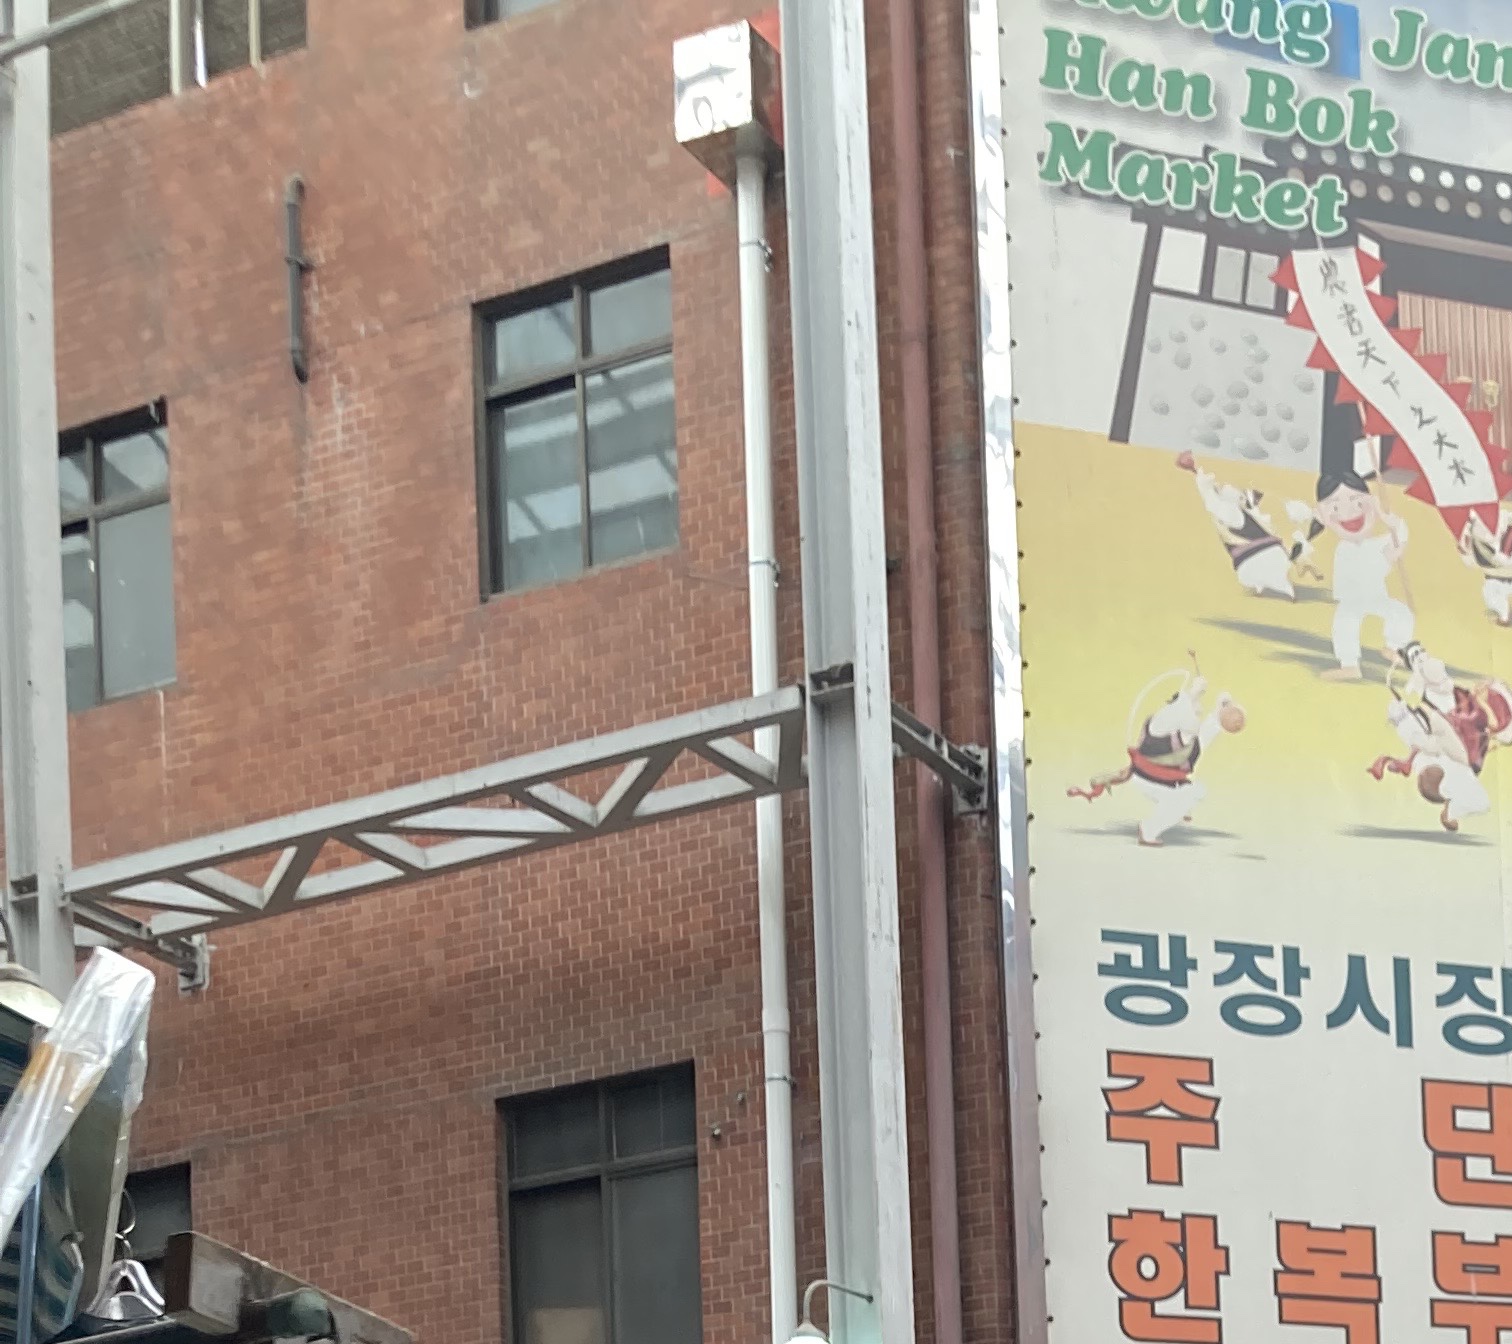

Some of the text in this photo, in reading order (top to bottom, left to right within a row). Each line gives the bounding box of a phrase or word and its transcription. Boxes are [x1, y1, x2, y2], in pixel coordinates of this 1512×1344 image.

[1039, 27, 1399, 155] Han Bok
[1039, 121, 1348, 235] Market
